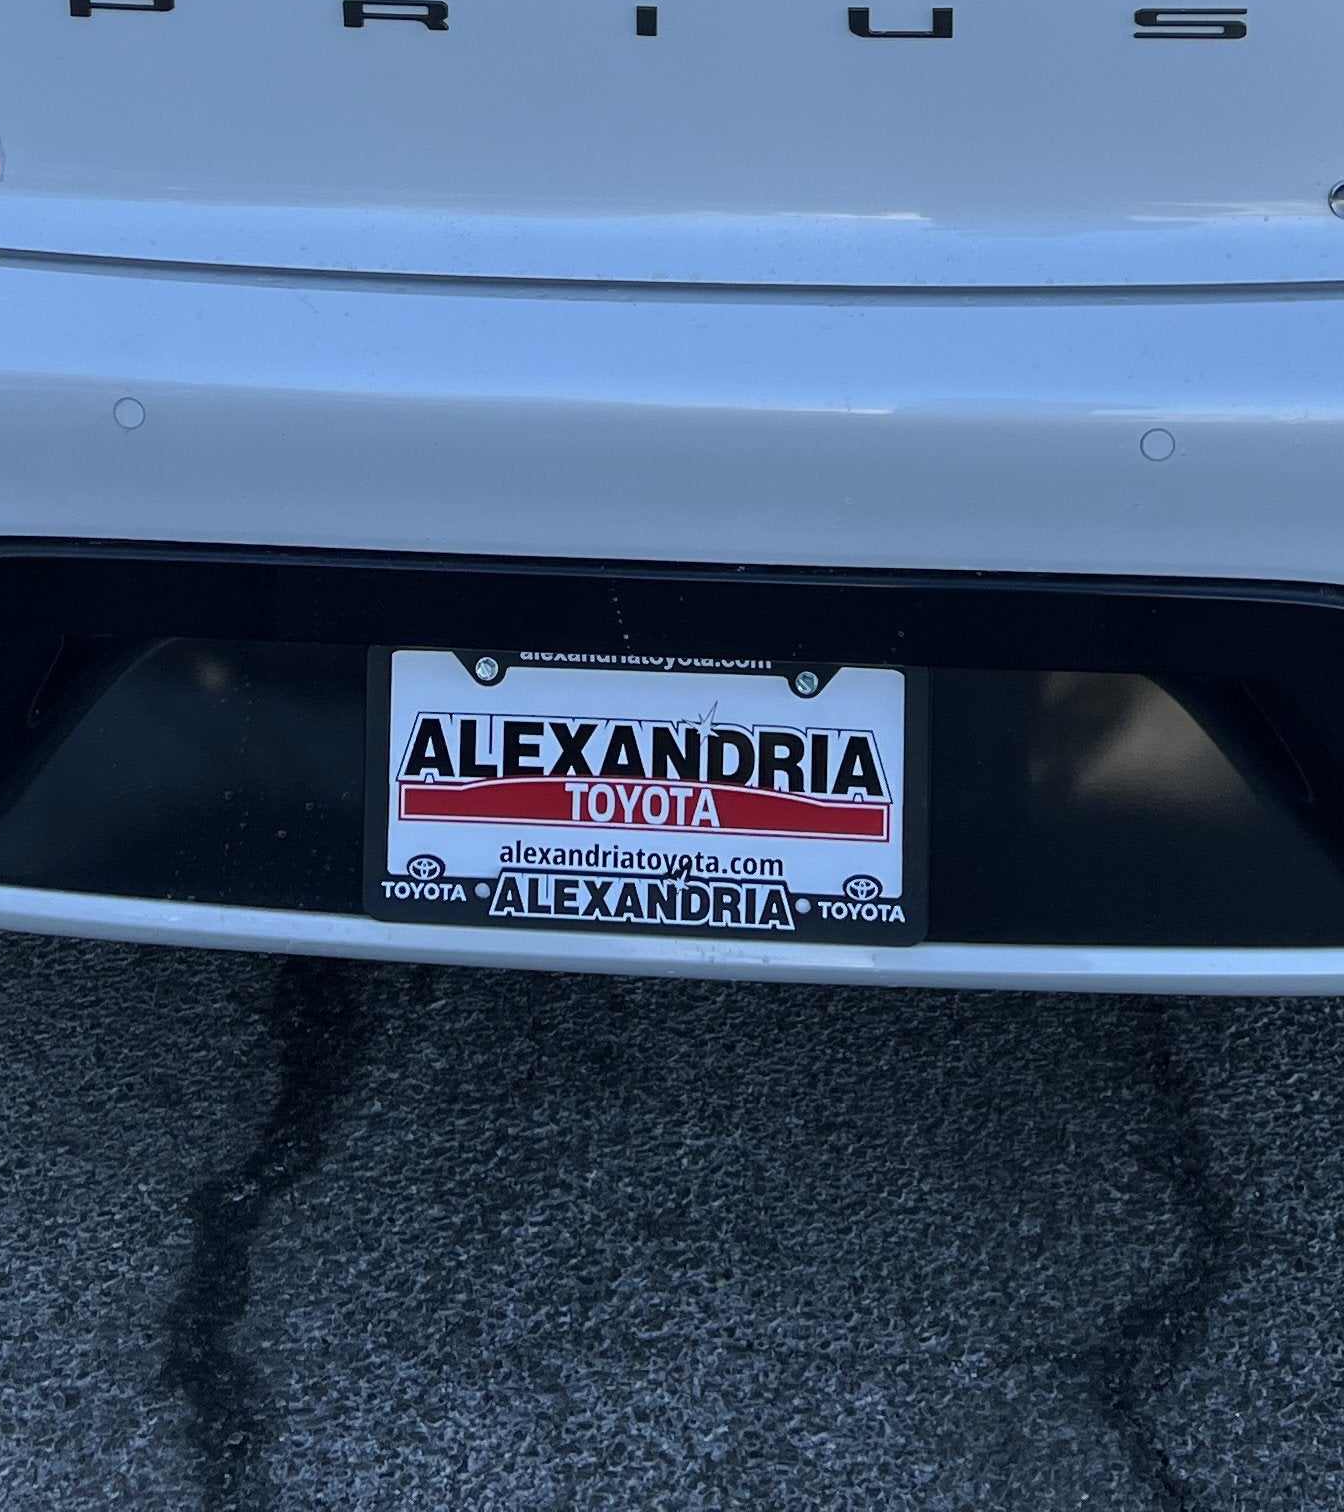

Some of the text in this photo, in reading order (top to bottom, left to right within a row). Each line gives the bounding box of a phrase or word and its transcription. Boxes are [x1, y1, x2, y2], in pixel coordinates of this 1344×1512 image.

[402, 716, 886, 798] ALEXANDRIA
[565, 783, 721, 828] TOYOTA
[499, 840, 784, 877] alexandriatoyota.com
[382, 880, 467, 903] TOYOTA
[492, 874, 793, 928] ALEXANDRIA
[818, 900, 906, 924] TOYOTA
